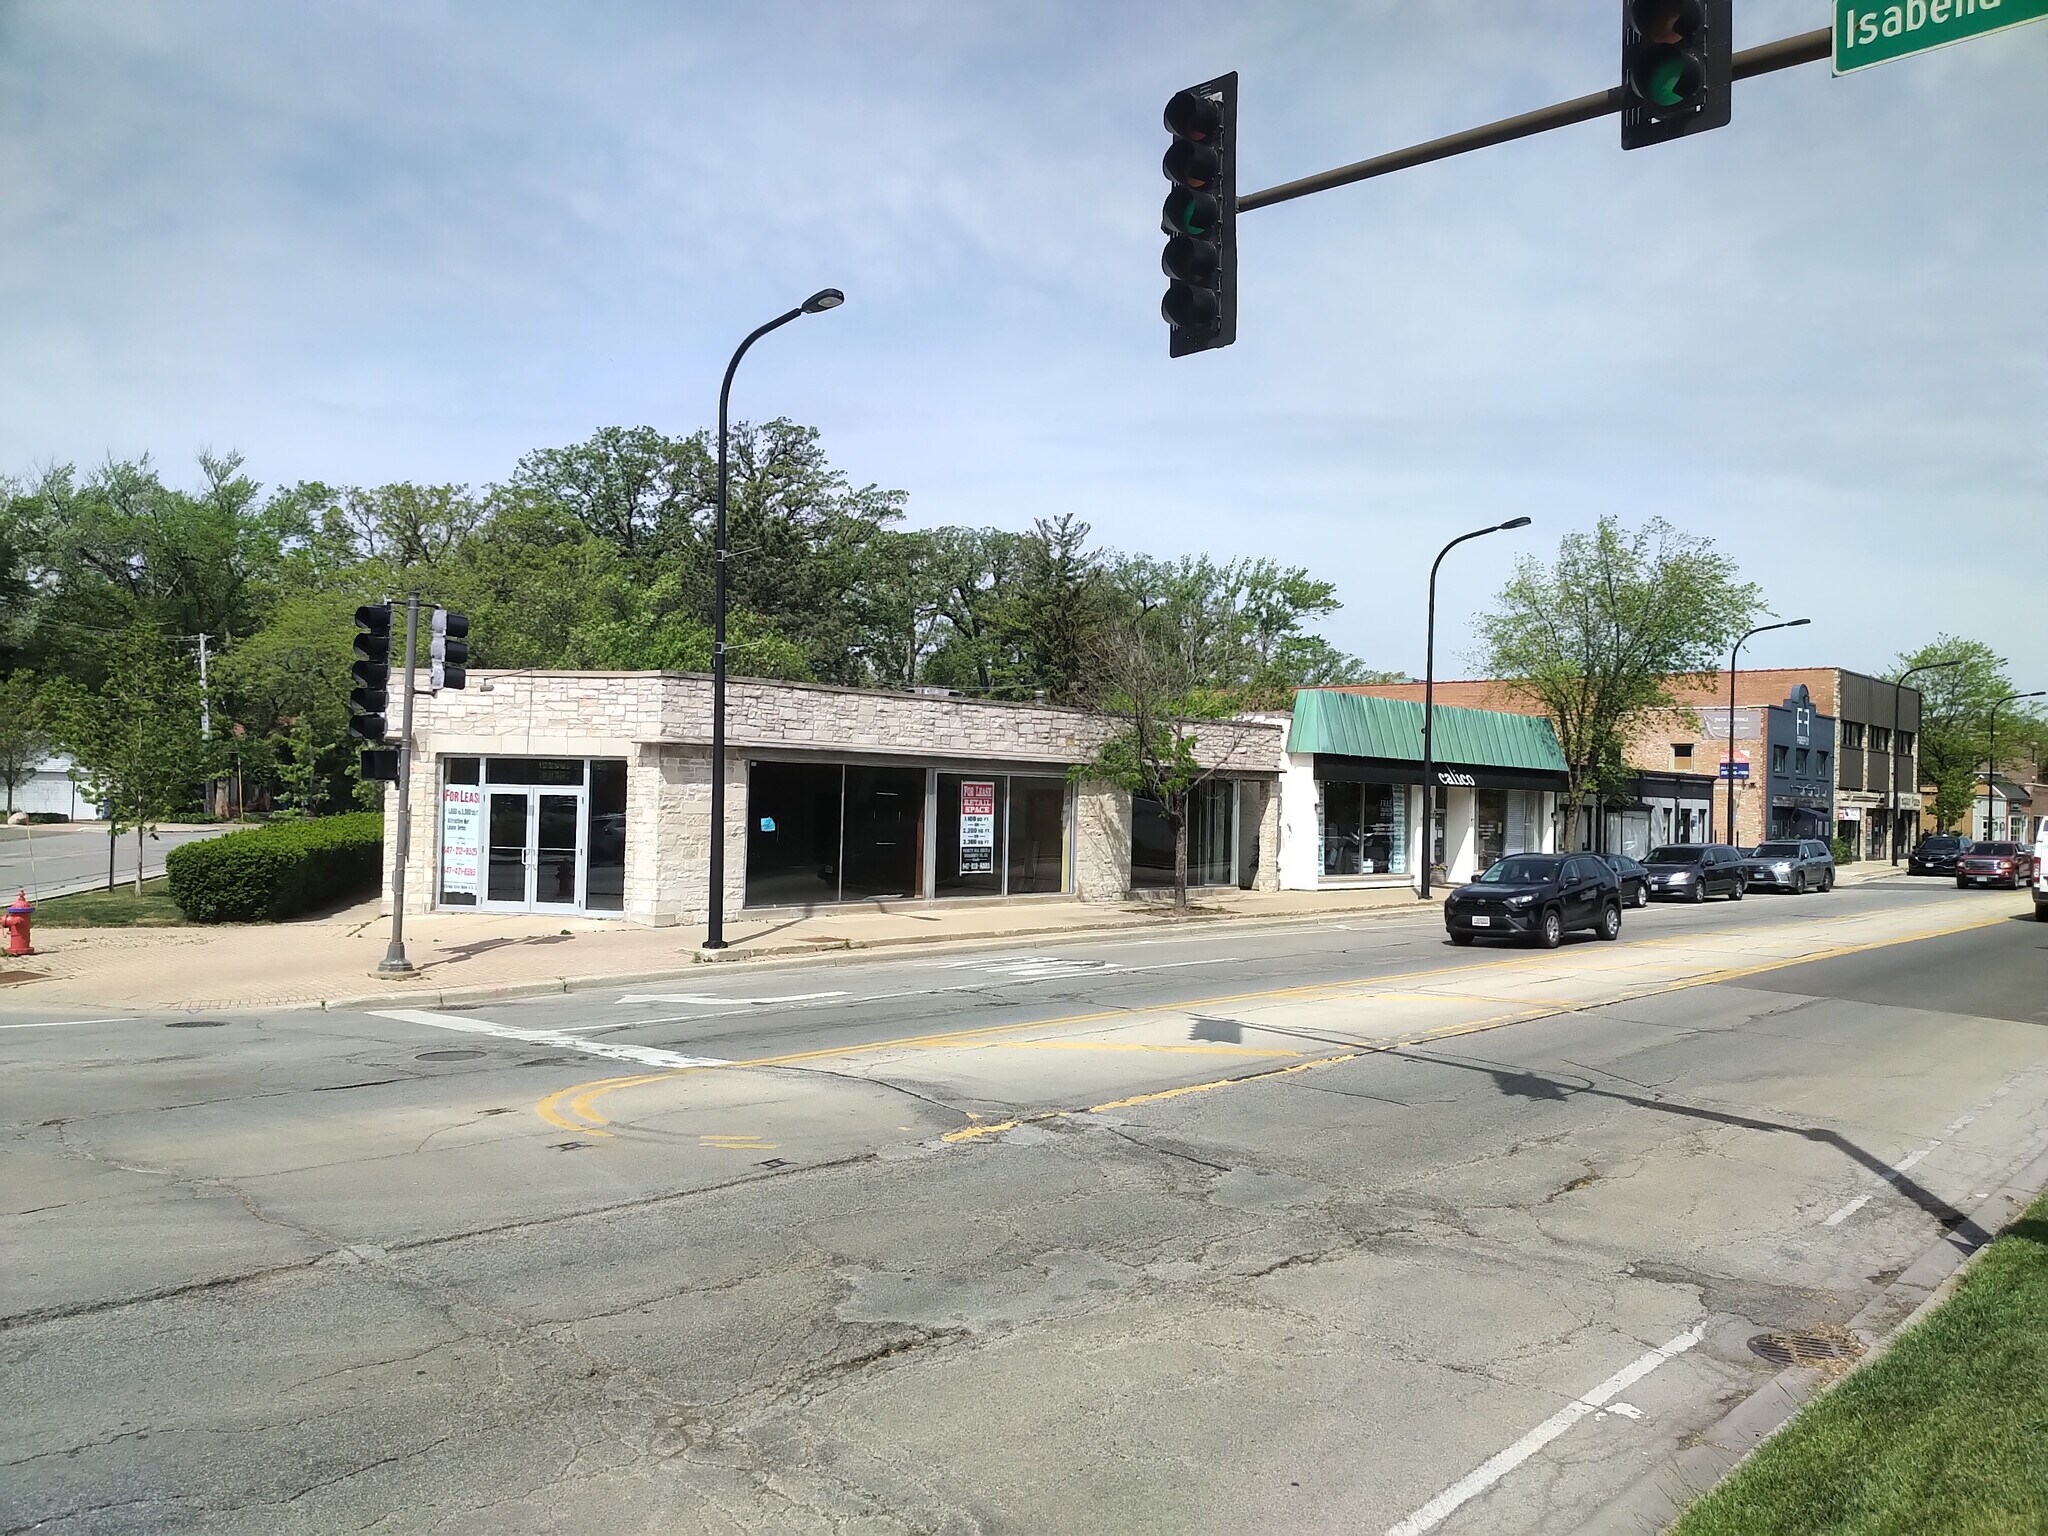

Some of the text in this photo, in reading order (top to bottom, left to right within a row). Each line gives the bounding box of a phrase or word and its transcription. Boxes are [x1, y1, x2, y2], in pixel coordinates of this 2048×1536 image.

[1438, 764, 1476, 786] calico
[445, 789, 480, 803] FOR LEAS
[964, 786, 991, 796] FOR LEASE
